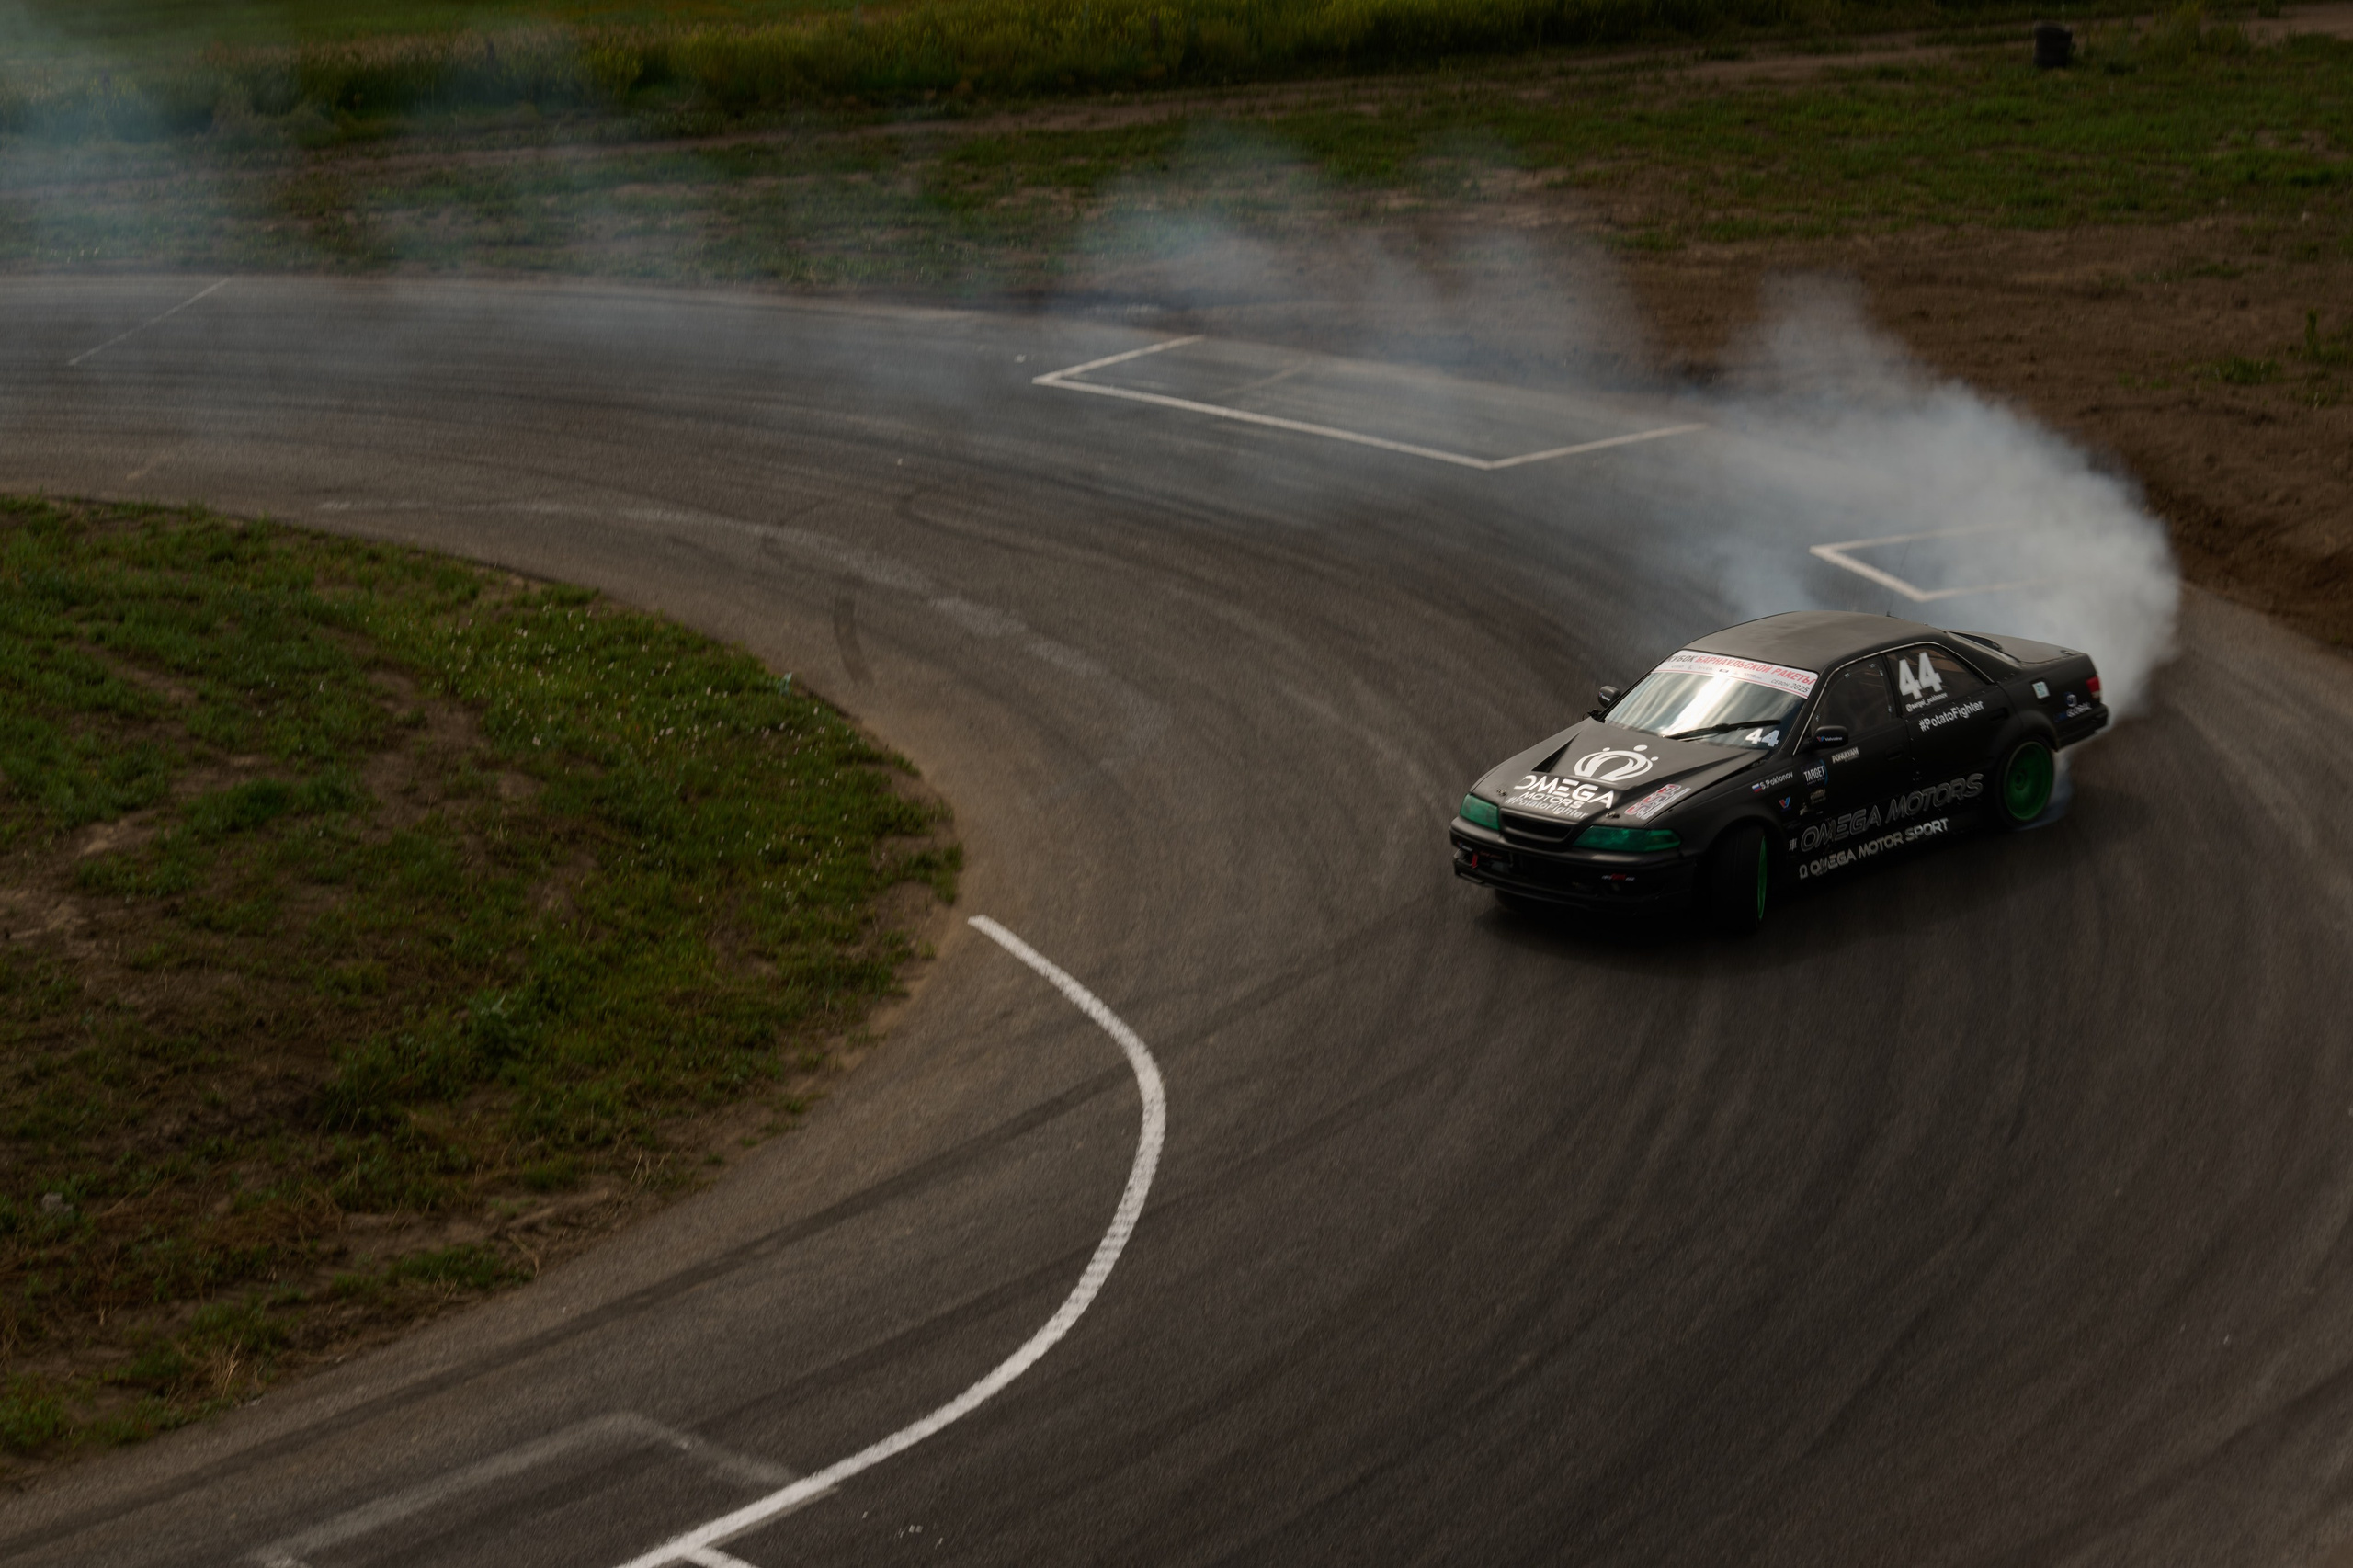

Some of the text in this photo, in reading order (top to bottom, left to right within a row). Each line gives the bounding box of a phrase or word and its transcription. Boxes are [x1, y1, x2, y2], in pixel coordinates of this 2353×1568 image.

[1695, 655, 1774, 674] БАРНАУЛЬСКОЙ
[1771, 667, 1817, 686] РАКЕТЫ
[1899, 652, 1943, 699] 44
[1789, 683, 1811, 694] 2025
[1918, 700, 1984, 733] #PotatoFighter
[1745, 728, 1780, 747] 44
[1759, 771, 1793, 790] S.Poklonov
[1803, 765, 1826, 782] TARGET
[1513, 775, 1614, 810] OMEGA
[1519, 791, 1585, 809] MOTORS
[1885, 773, 1984, 824] MOTORS
[1505, 796, 1588, 820] #PotatoFighter
[1810, 817, 1949, 877] OMEGA MOTOR SPORT
